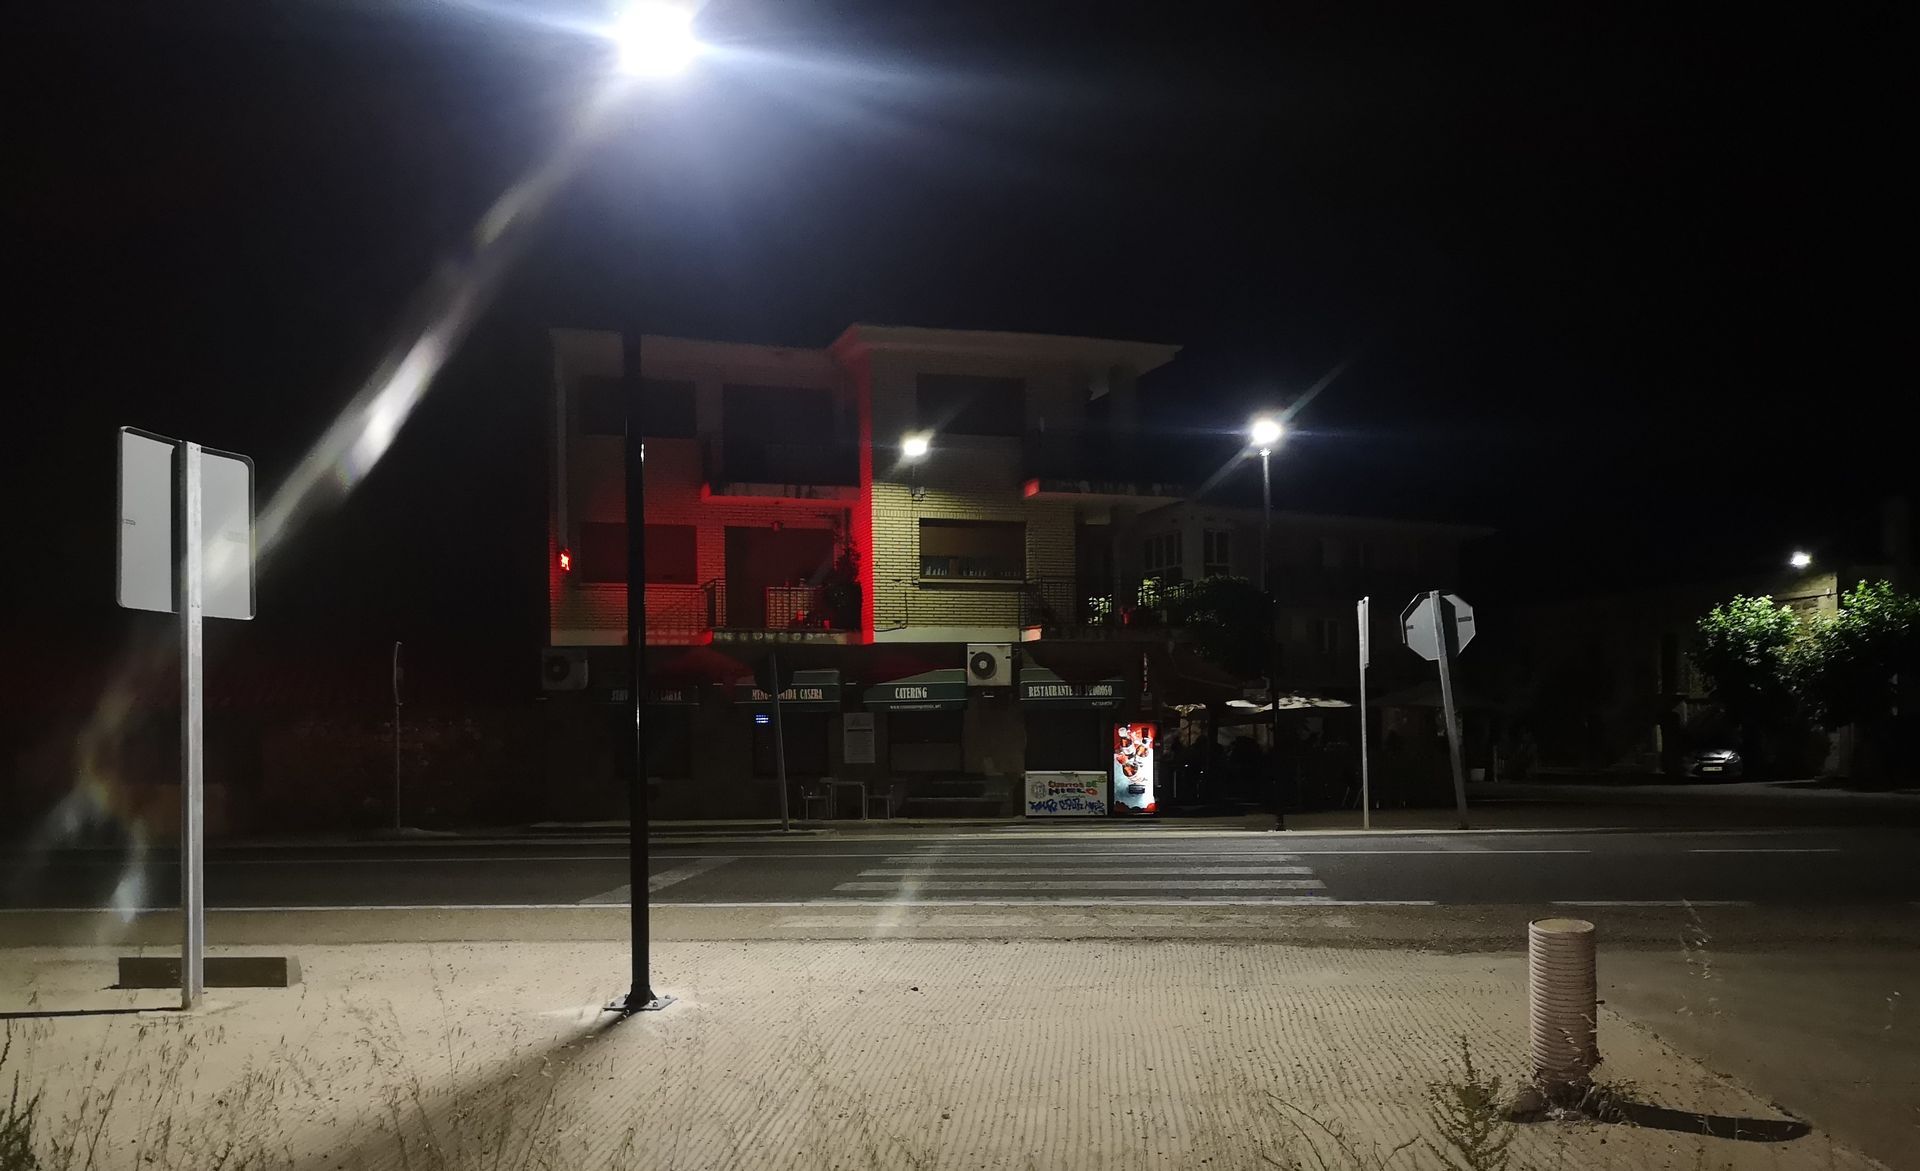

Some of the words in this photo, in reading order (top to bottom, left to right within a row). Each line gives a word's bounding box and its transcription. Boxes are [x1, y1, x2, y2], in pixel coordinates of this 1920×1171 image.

[799, 688, 823, 700] CASERA
[895, 687, 928, 699] CATERING
[1028, 685, 1073, 697] RESTAURANTE
